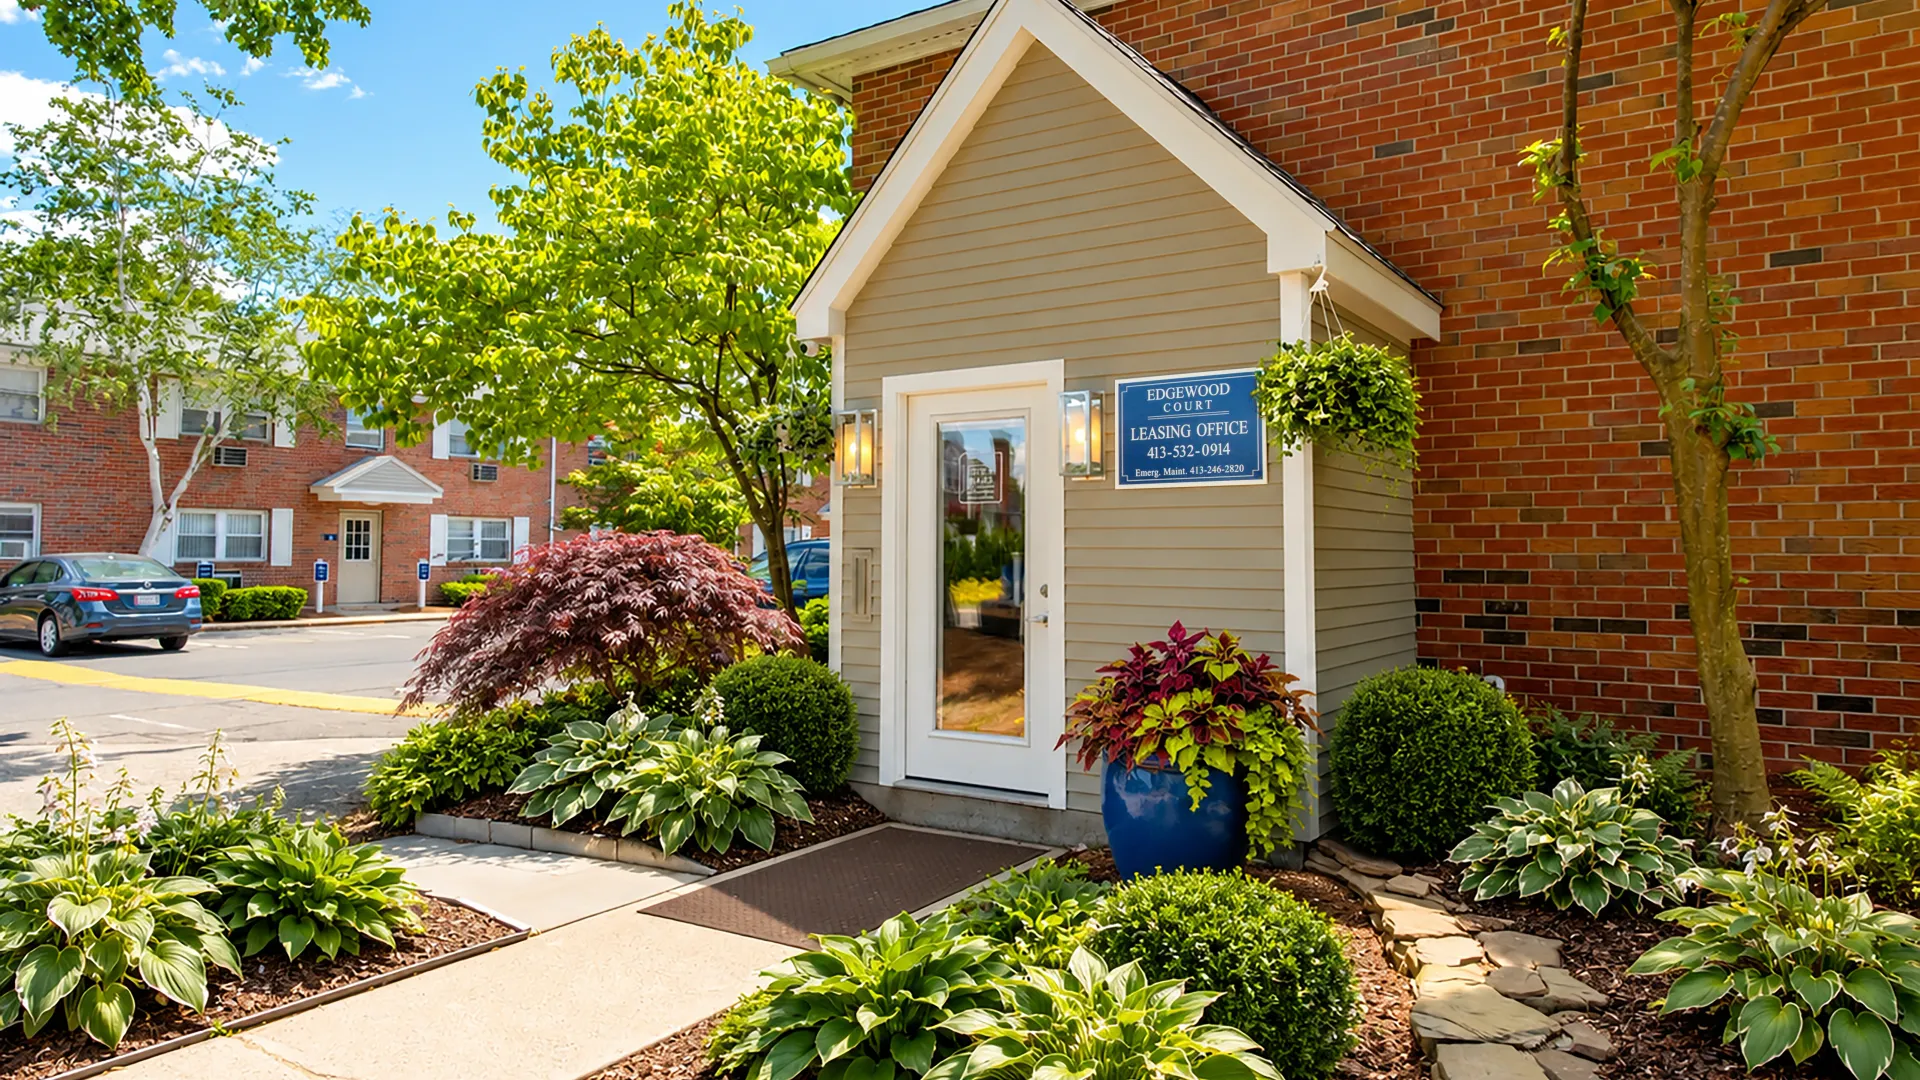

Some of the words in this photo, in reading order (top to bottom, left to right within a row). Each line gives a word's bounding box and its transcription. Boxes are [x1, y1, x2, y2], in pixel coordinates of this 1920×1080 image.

[1147, 383, 1230, 401] EDGEWOOD
[1163, 400, 1212, 412] COURT
[1131, 424, 1191, 441] LEASING
[1197, 420, 1248, 436] OFFICE
[1147, 442, 1230, 459] 413-532-0914
[1135, 469, 1160, 478] Emerg.
[1163, 467, 1187, 476] Maint.
[1190, 464, 1245, 475] 413-246-2820
